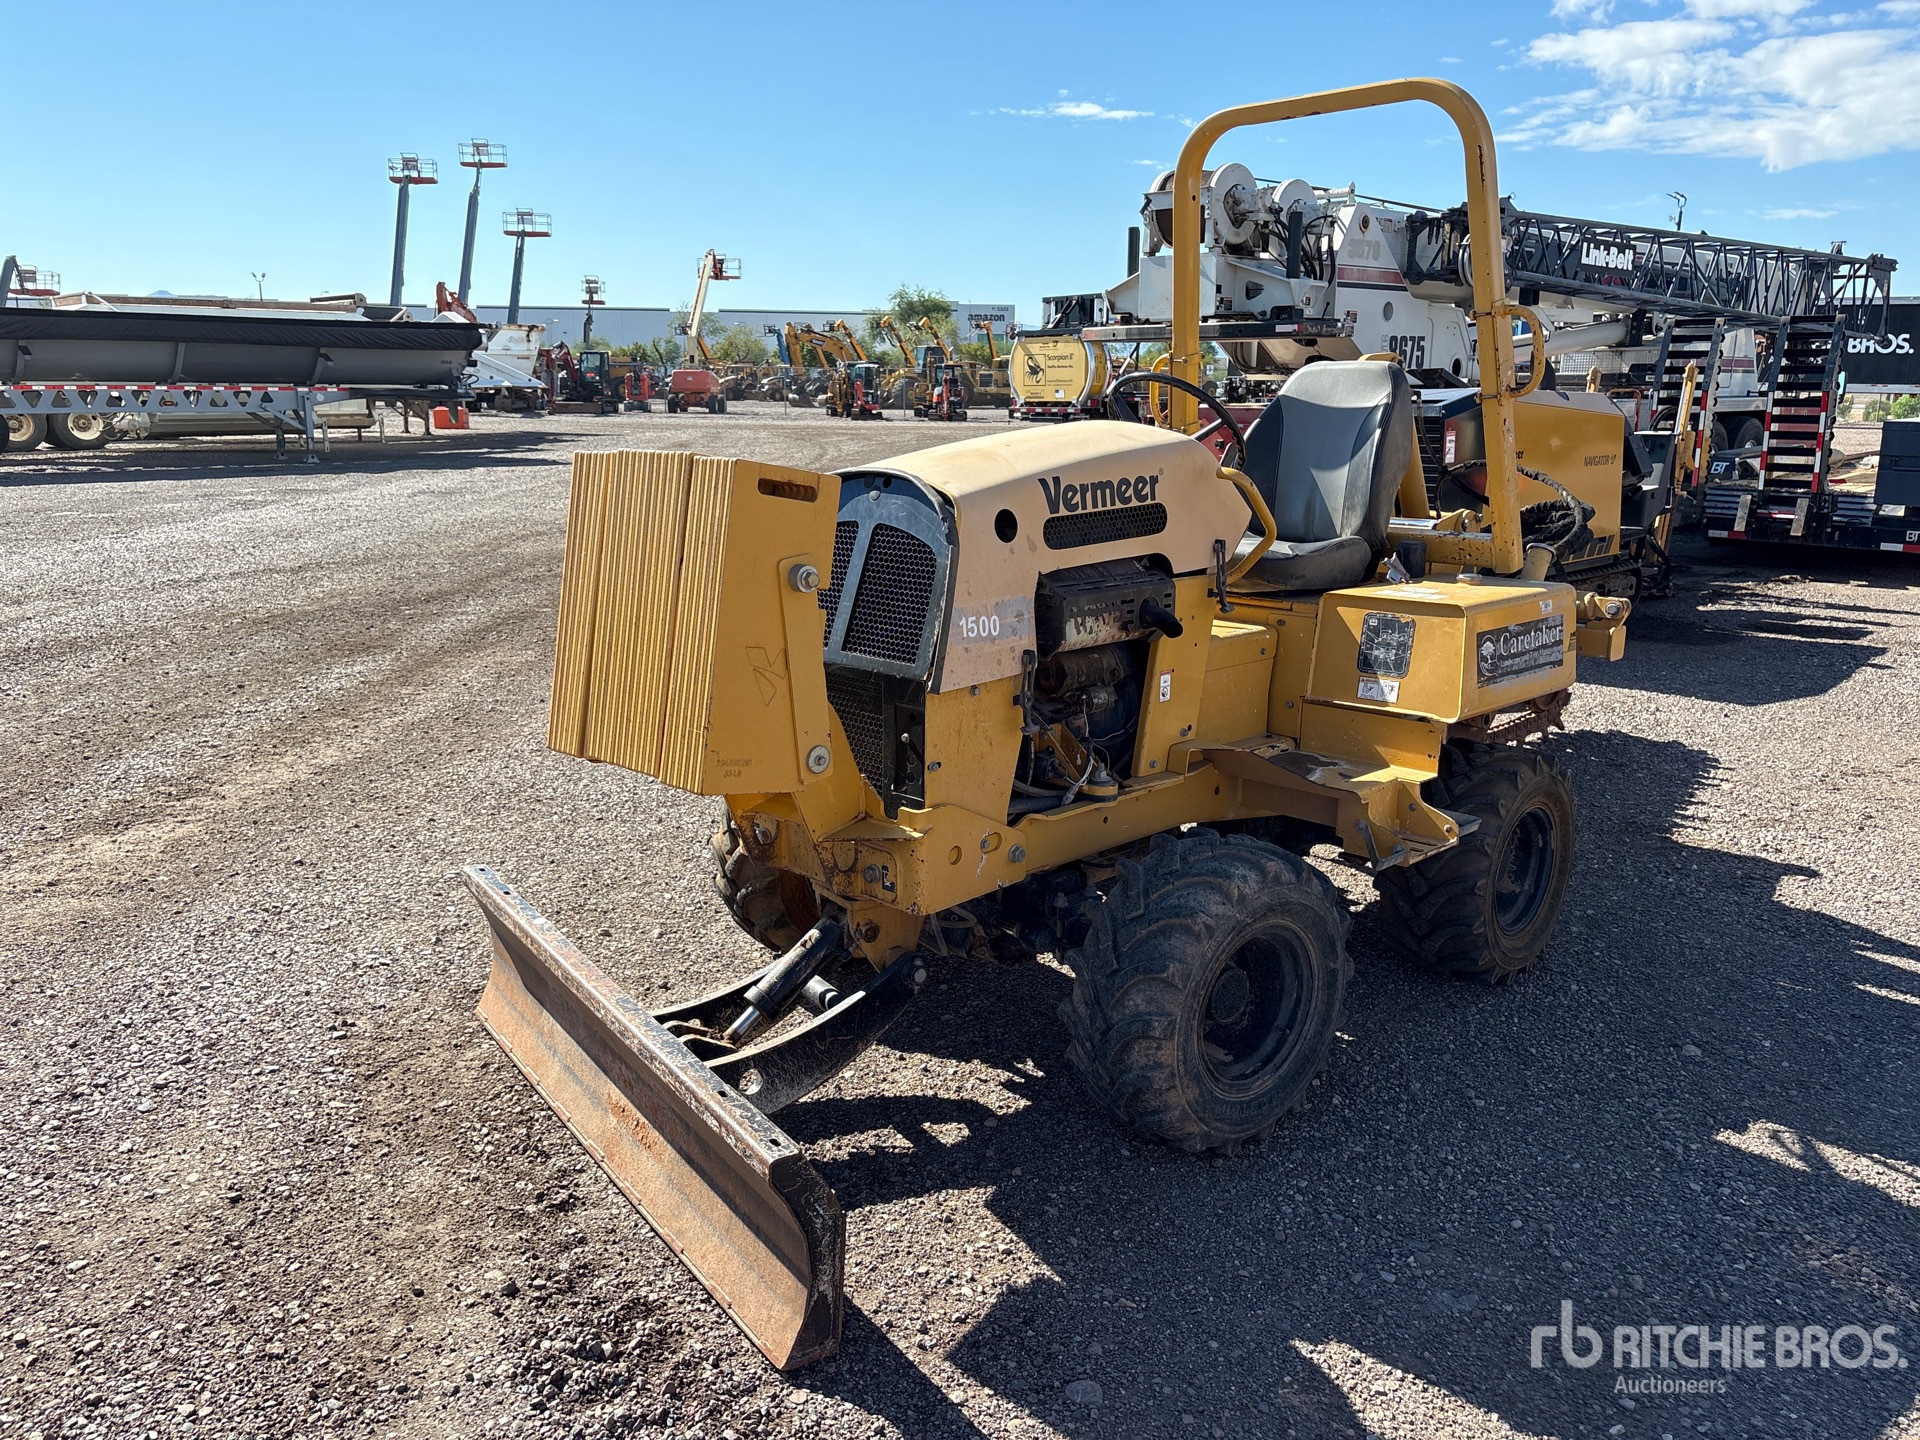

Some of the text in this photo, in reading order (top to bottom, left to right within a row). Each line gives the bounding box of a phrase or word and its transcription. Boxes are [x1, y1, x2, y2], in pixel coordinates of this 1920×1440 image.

[1581, 241, 1634, 271] Link-Belt
[967, 313, 1005, 322] amazon
[1046, 353, 1068, 362] Scorpion
[1584, 455, 1610, 467] NAVIGATOR
[1710, 461, 1730, 474] BT
[1037, 475, 1159, 515] Vermeer
[959, 615, 1000, 638] 1500
[1500, 624, 1562, 656] Caretaker
